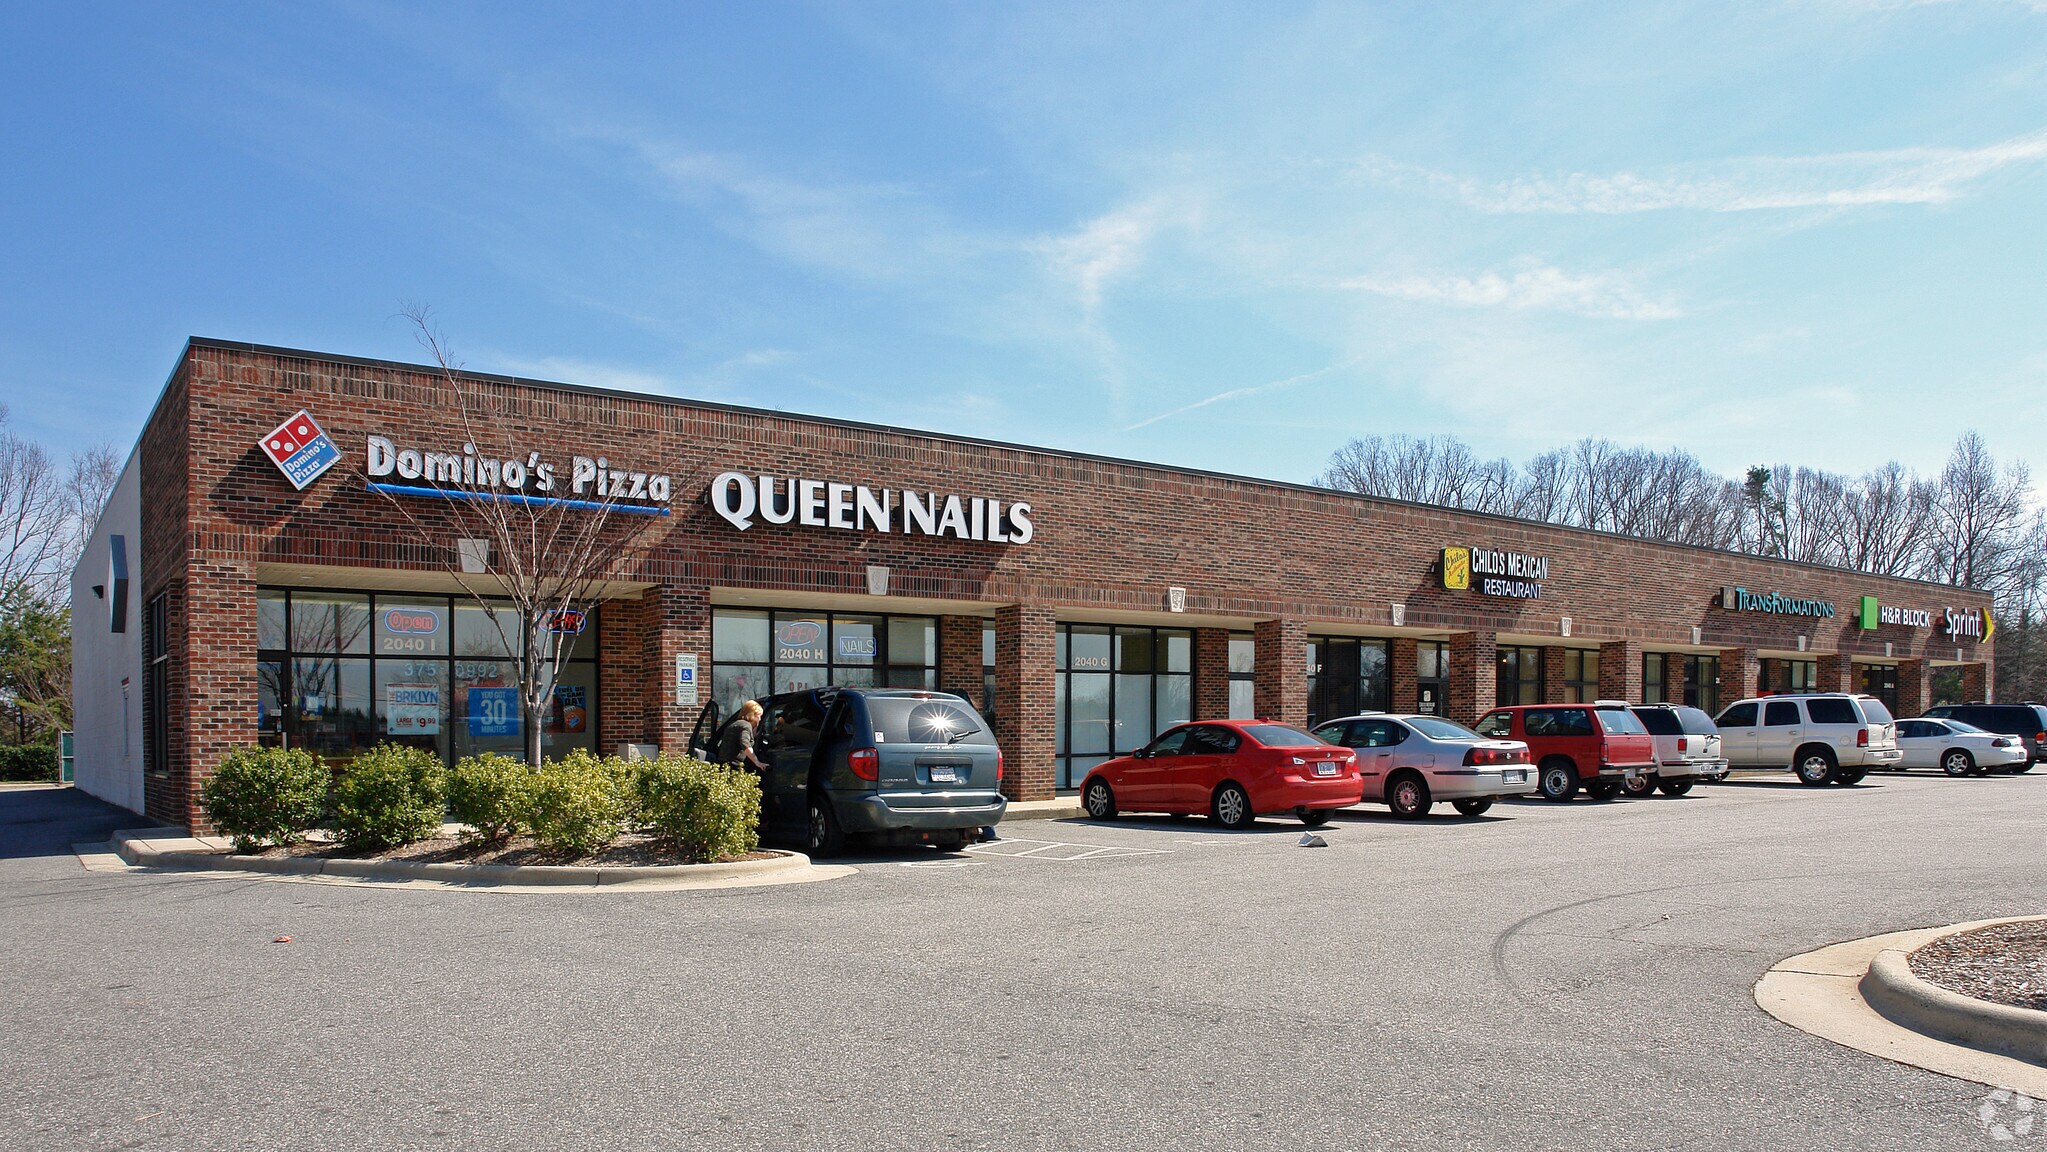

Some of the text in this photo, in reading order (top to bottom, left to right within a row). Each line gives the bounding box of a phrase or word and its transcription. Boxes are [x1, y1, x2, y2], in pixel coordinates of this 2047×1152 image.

[285, 440, 327, 473] Domino's
[293, 460, 321, 482] Pizza
[367, 435, 671, 502] Domino's Pizza
[711, 471, 1034, 545] QUEEN NAILS
[1508, 552, 1548, 579] MEXICAN
[1484, 578, 1542, 599] RESTAURANT
[388, 611, 433, 632] Open
[1881, 606, 1931, 628] H&R BLOCK
[1945, 606, 1981, 643] Sprint
[780, 625, 818, 643] OPEN
[383, 638, 425, 651] 2040
[841, 639, 874, 654] NAILS
[780, 649, 824, 660] 2040 H
[1074, 657, 1108, 667] 2040 G
[1317, 664, 1322, 673] F
[395, 690, 439, 704] BRKLYN
[481, 691, 493, 699] YOU
[564, 697, 584, 705] DAY
[480, 699, 507, 726] 30
[481, 725, 507, 734] MINUTES
